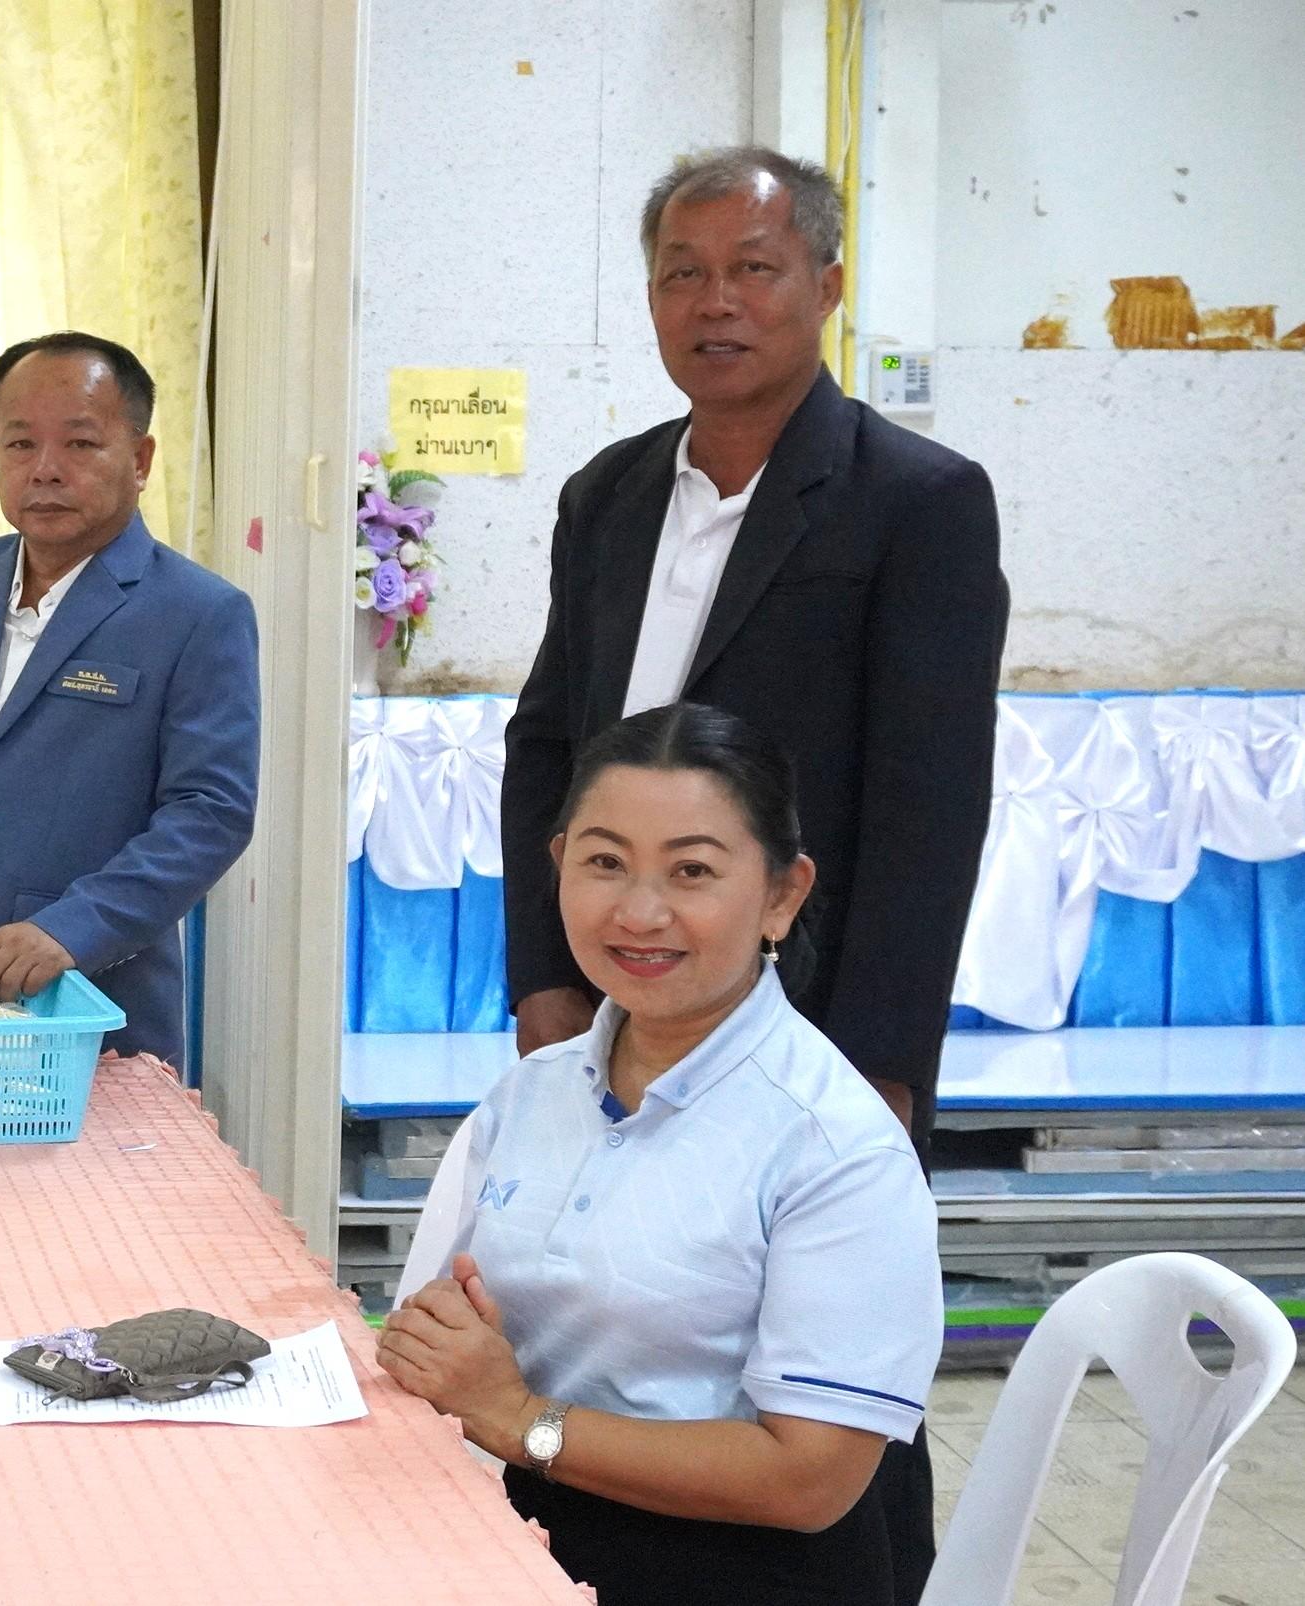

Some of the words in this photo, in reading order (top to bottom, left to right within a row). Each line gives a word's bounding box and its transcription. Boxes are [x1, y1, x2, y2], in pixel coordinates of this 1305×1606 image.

[409, 386, 507, 421] กรุณาเลื่อน
[415, 432, 498, 461] ม่านเบาๆ
